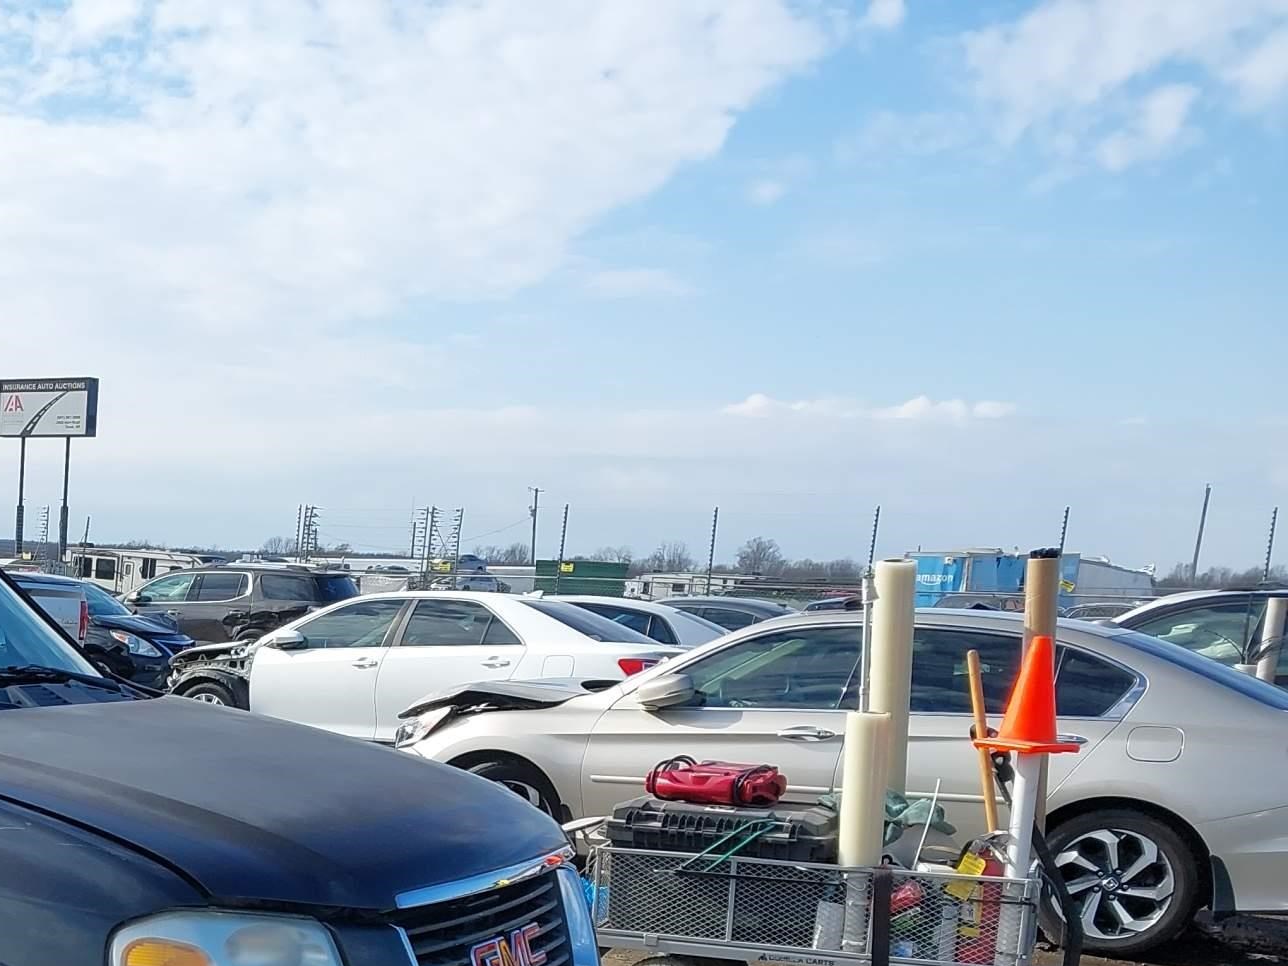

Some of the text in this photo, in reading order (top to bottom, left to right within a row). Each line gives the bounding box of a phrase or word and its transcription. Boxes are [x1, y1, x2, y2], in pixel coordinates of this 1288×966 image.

[2, 383, 36, 391] INSURANCE
[55, 382, 85, 390] AUCTIONS
[915, 574, 954, 583] amazon
